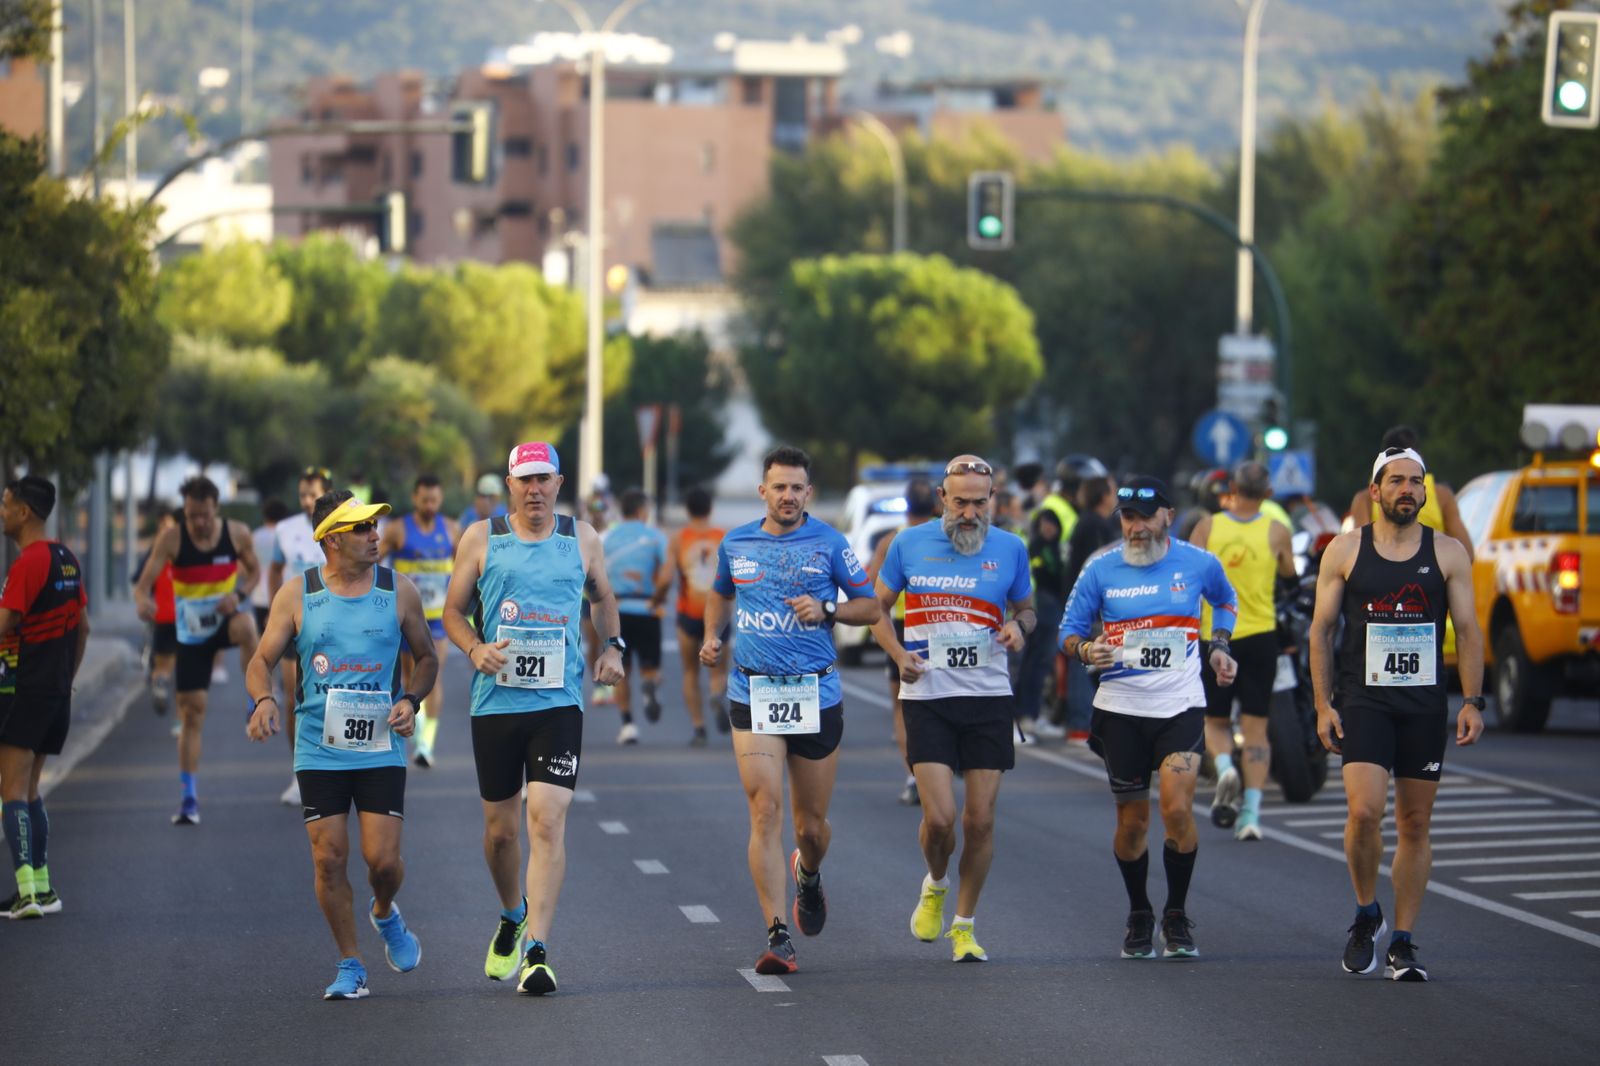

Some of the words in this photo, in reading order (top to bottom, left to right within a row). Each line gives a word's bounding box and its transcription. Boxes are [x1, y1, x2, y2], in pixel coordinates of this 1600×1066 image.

[909, 575, 978, 590] enerplus
[1105, 584, 1160, 599] enerplus
[920, 594, 972, 608] Maratón
[925, 611, 969, 622] Lucena
[1370, 635, 1395, 643] MEDIA
[515, 656, 545, 677] 321
[946, 646, 978, 668] 325
[1140, 647, 1171, 668] 382
[1384, 652, 1420, 675] 456
[768, 702, 803, 723] 324
[344, 718, 375, 741] 381
